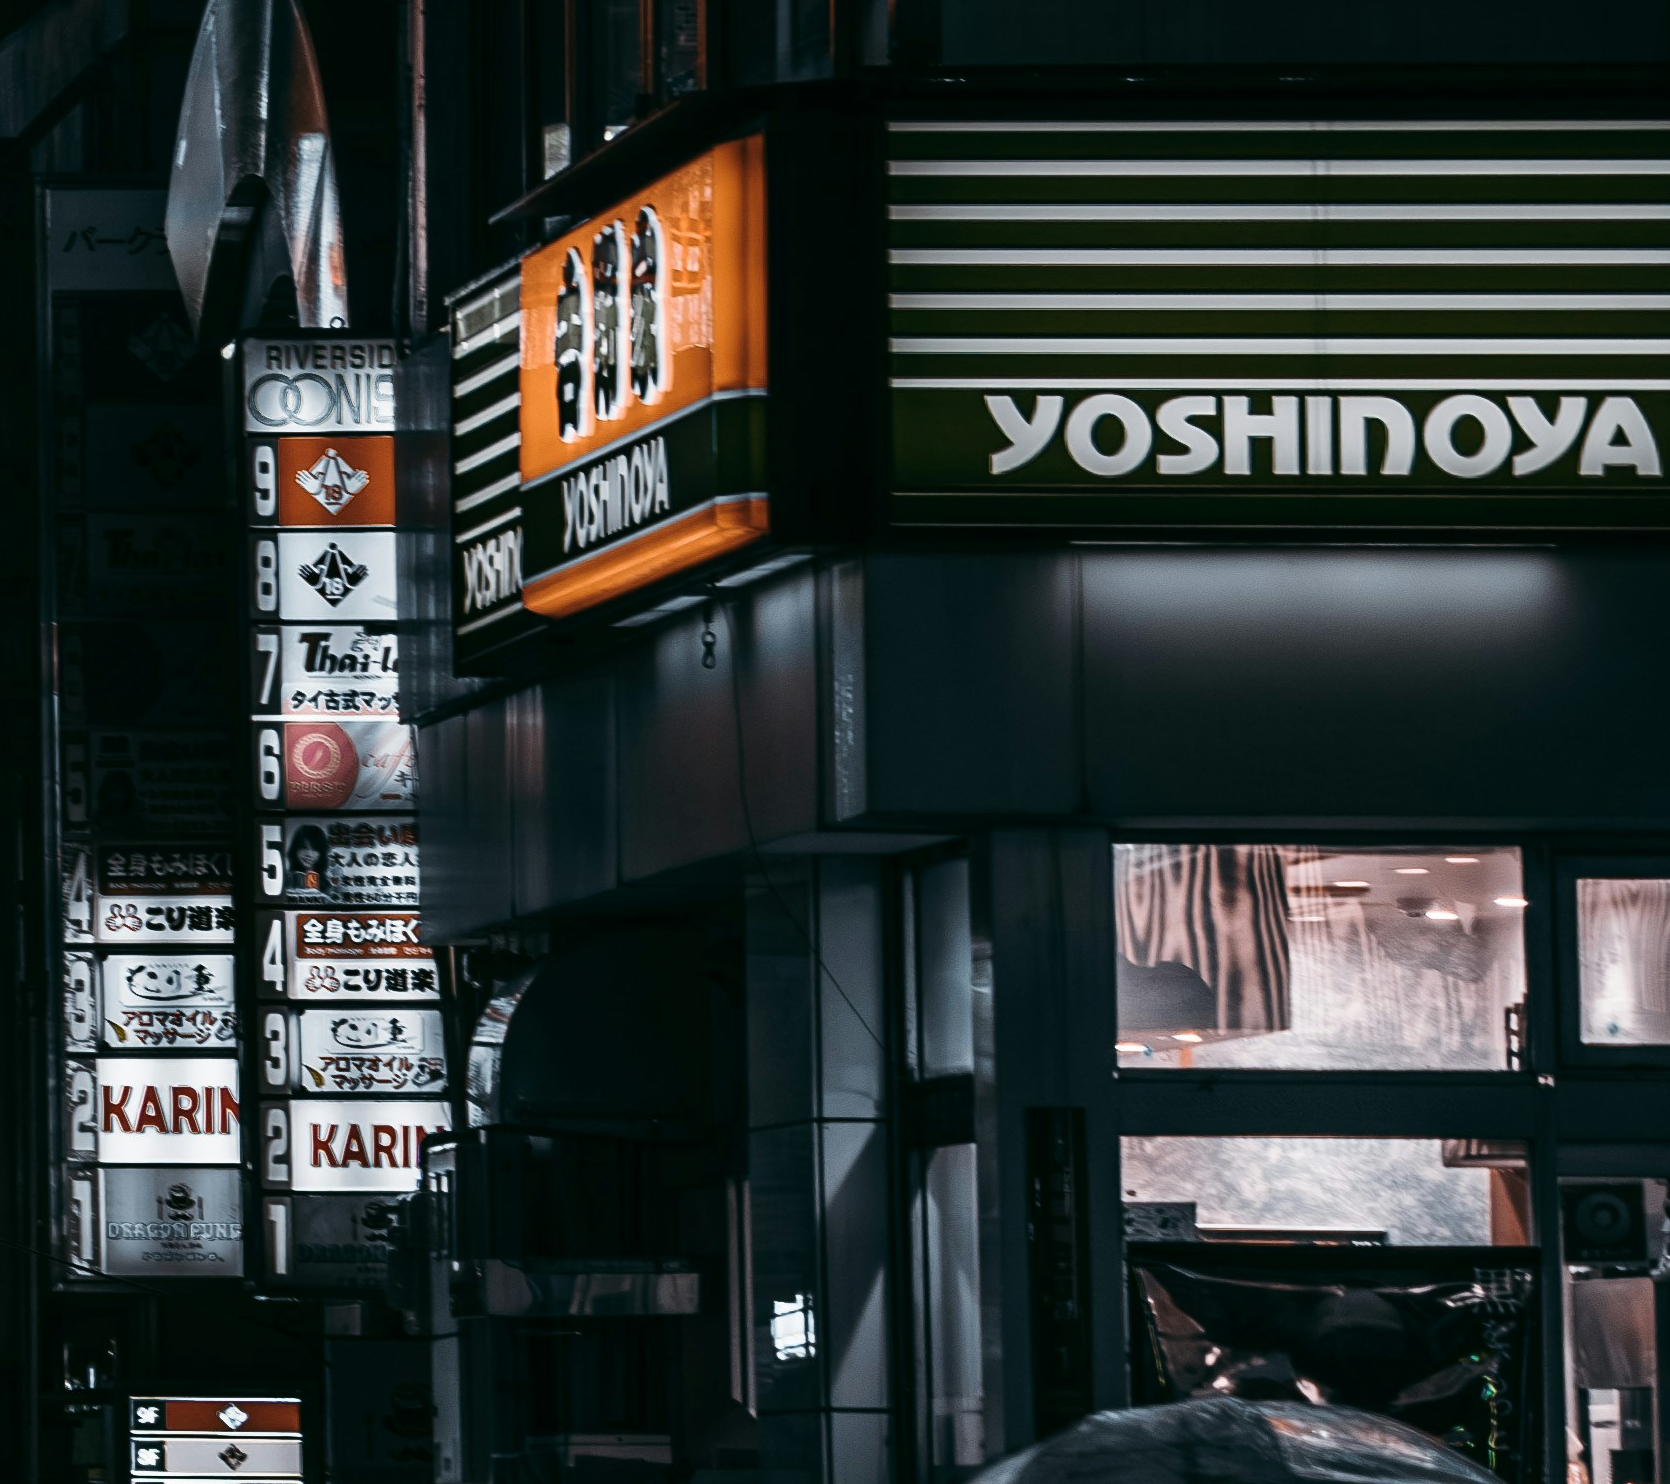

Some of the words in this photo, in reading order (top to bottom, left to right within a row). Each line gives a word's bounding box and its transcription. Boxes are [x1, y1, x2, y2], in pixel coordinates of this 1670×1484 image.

[985, 393, 1660, 478] YOSHINOYA
[254, 445, 277, 516] 9
[562, 436, 671, 554] YOSHINOYA
[254, 540, 278, 611] 8
[256, 634, 279, 704] 7
[259, 728, 282, 800] 6
[261, 823, 285, 896] 5
[263, 919, 286, 992] 4
[343, 968, 440, 993] こり道楽
[70, 959, 94, 1044] 3
[263, 1012, 287, 1087] 3
[319, 1055, 415, 1073] アロマオイル
[330, 1072, 409, 1091] マッサージ
[266, 1108, 289, 1183] 2
[271, 1203, 288, 1276] 1
